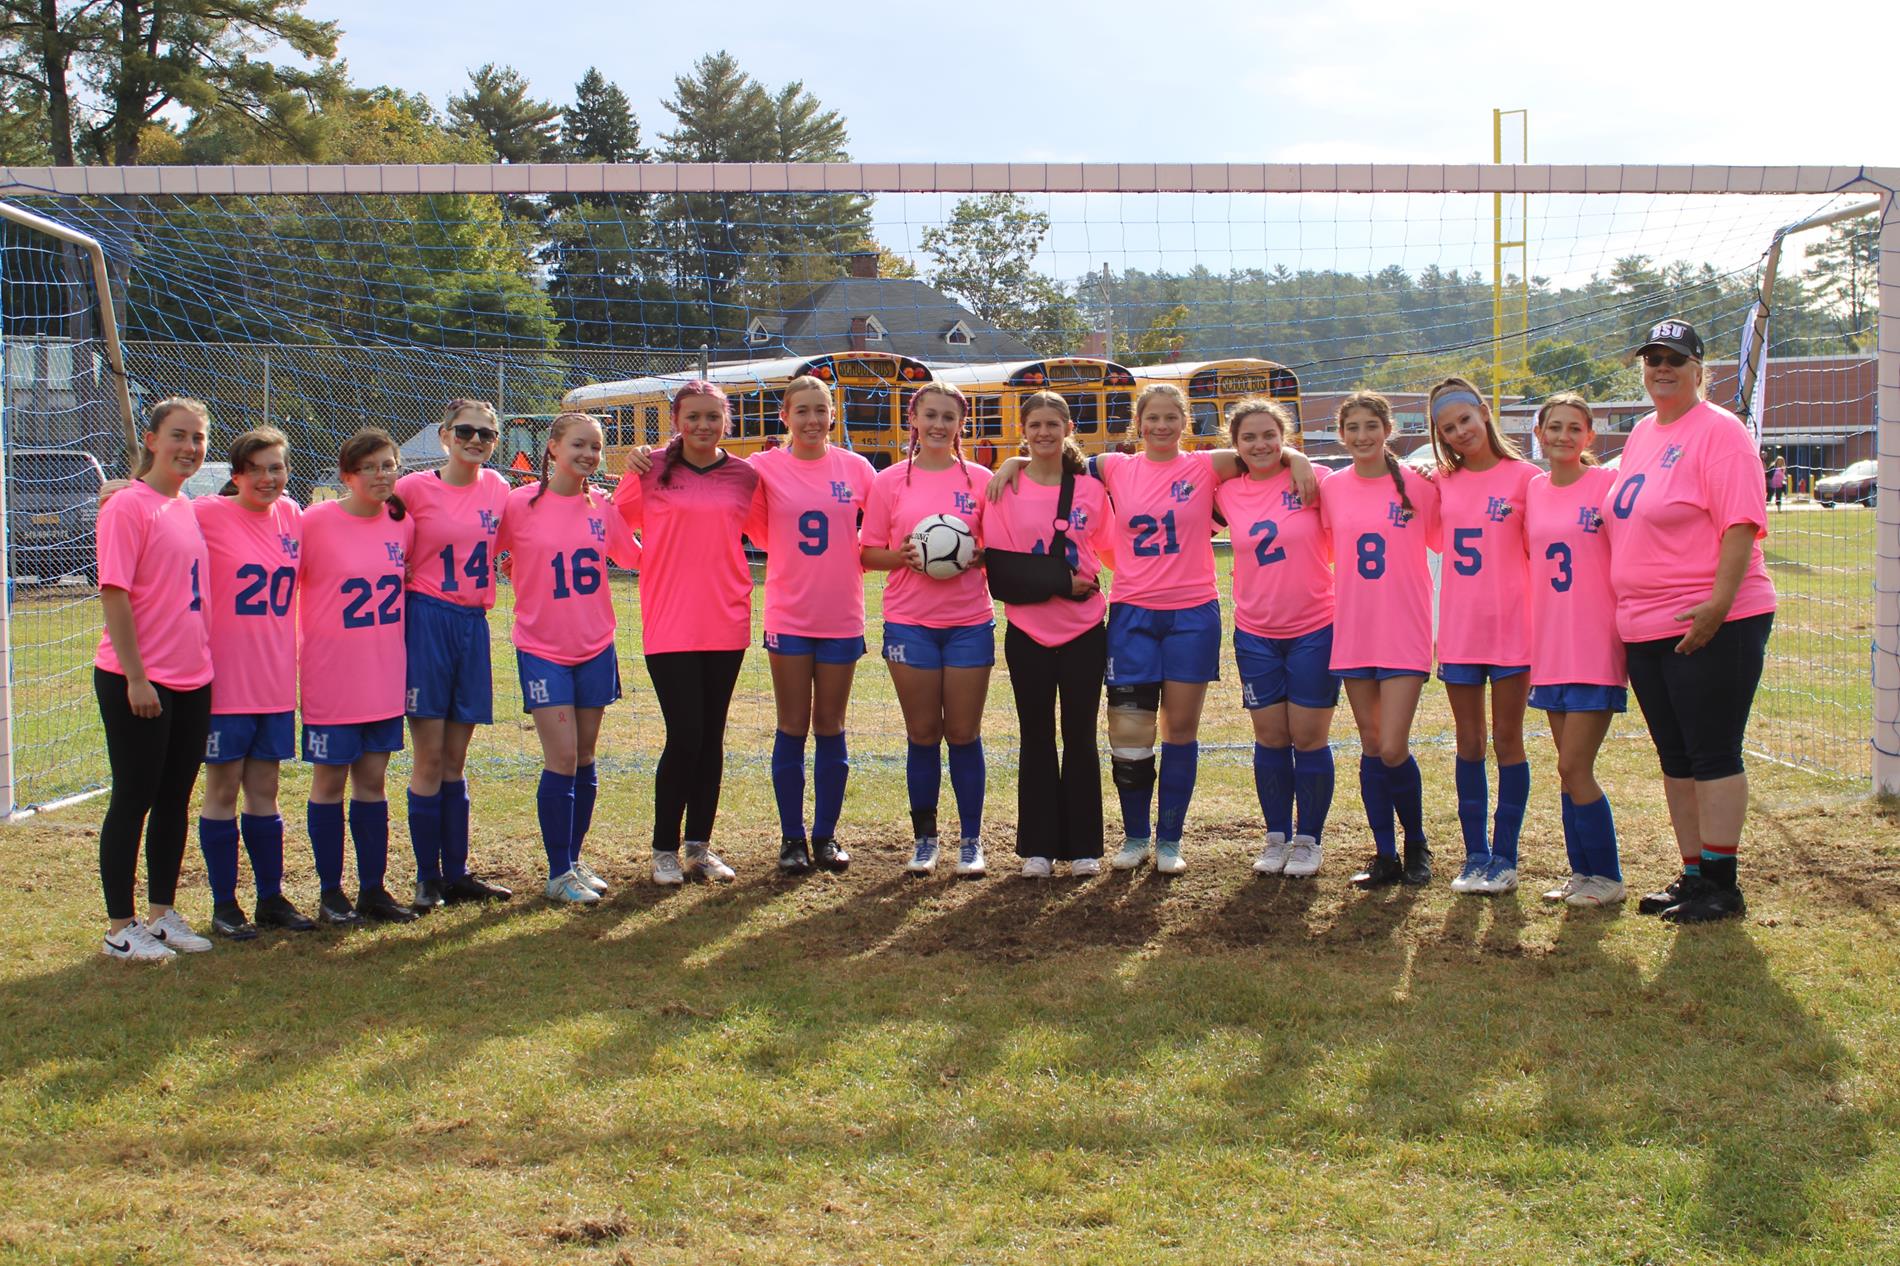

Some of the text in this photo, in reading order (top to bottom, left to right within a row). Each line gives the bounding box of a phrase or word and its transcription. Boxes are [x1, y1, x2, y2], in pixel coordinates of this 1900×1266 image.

[1222, 376, 1267, 392] SCHOOL BUS
[1612, 473, 1645, 519] 0
[798, 510, 829, 556] 9
[1129, 509, 1180, 557] 21
[1248, 519, 1287, 567] 2
[1356, 532, 1386, 580] 8
[1453, 528, 1483, 576] 5
[235, 563, 296, 617] 20
[439, 541, 489, 592] 14
[551, 547, 601, 600] 16
[1545, 541, 1573, 592] 3
[340, 574, 402, 629] 22
